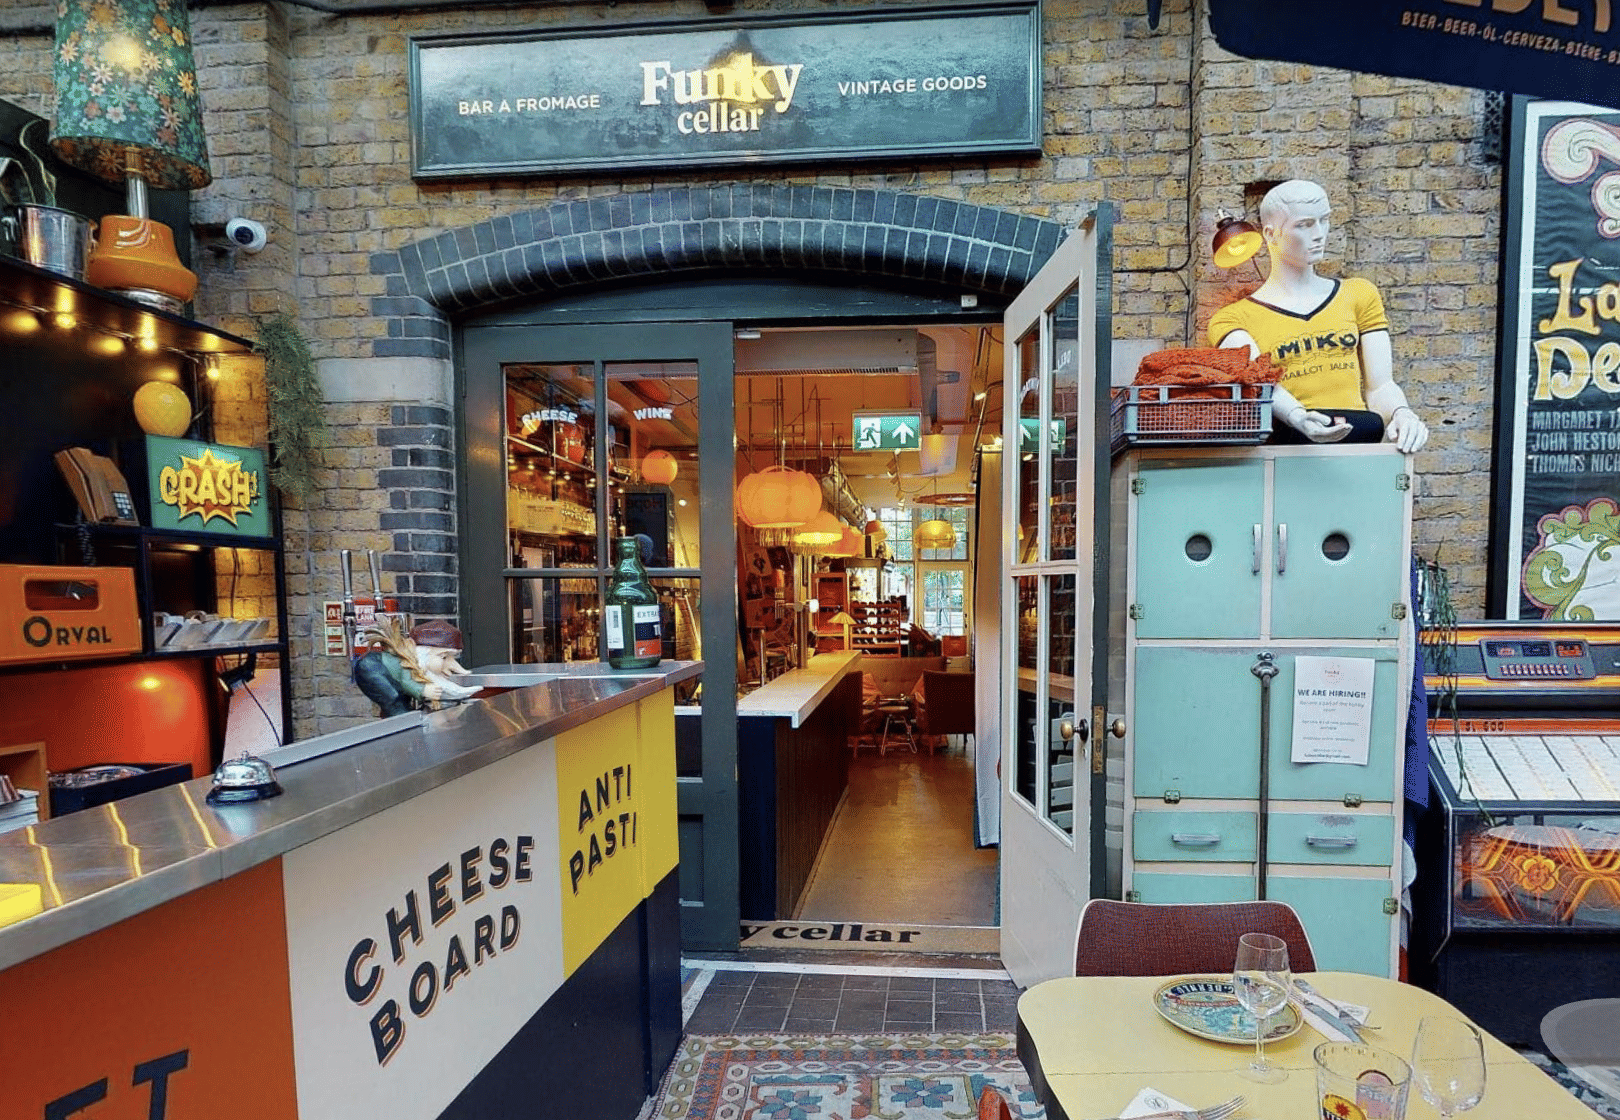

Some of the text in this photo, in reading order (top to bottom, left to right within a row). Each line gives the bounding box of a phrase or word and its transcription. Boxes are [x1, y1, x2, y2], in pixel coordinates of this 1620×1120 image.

[639, 52, 804, 113] Funky
[837, 75, 987, 96] VINTAGE GOODS
[458, 94, 601, 115] BAR A FROMAGE
[677, 101, 764, 134] cellar
[1277, 333, 1357, 359] MIKO
[522, 407, 673, 424] CHEESE WINE
[1532, 410, 1603, 429] MARGARET
[1531, 432, 1567, 451] JOHN
[1531, 453, 1585, 473] THOMAS
[1298, 689, 1366, 699] WE ARE HIRING!!
[578, 764, 631, 834] ANTI
[569, 812, 636, 897] PASTI
[345, 836, 534, 1006] CHEESE
[772, 924, 921, 943] cellar
[369, 905, 520, 1067] BOARD
